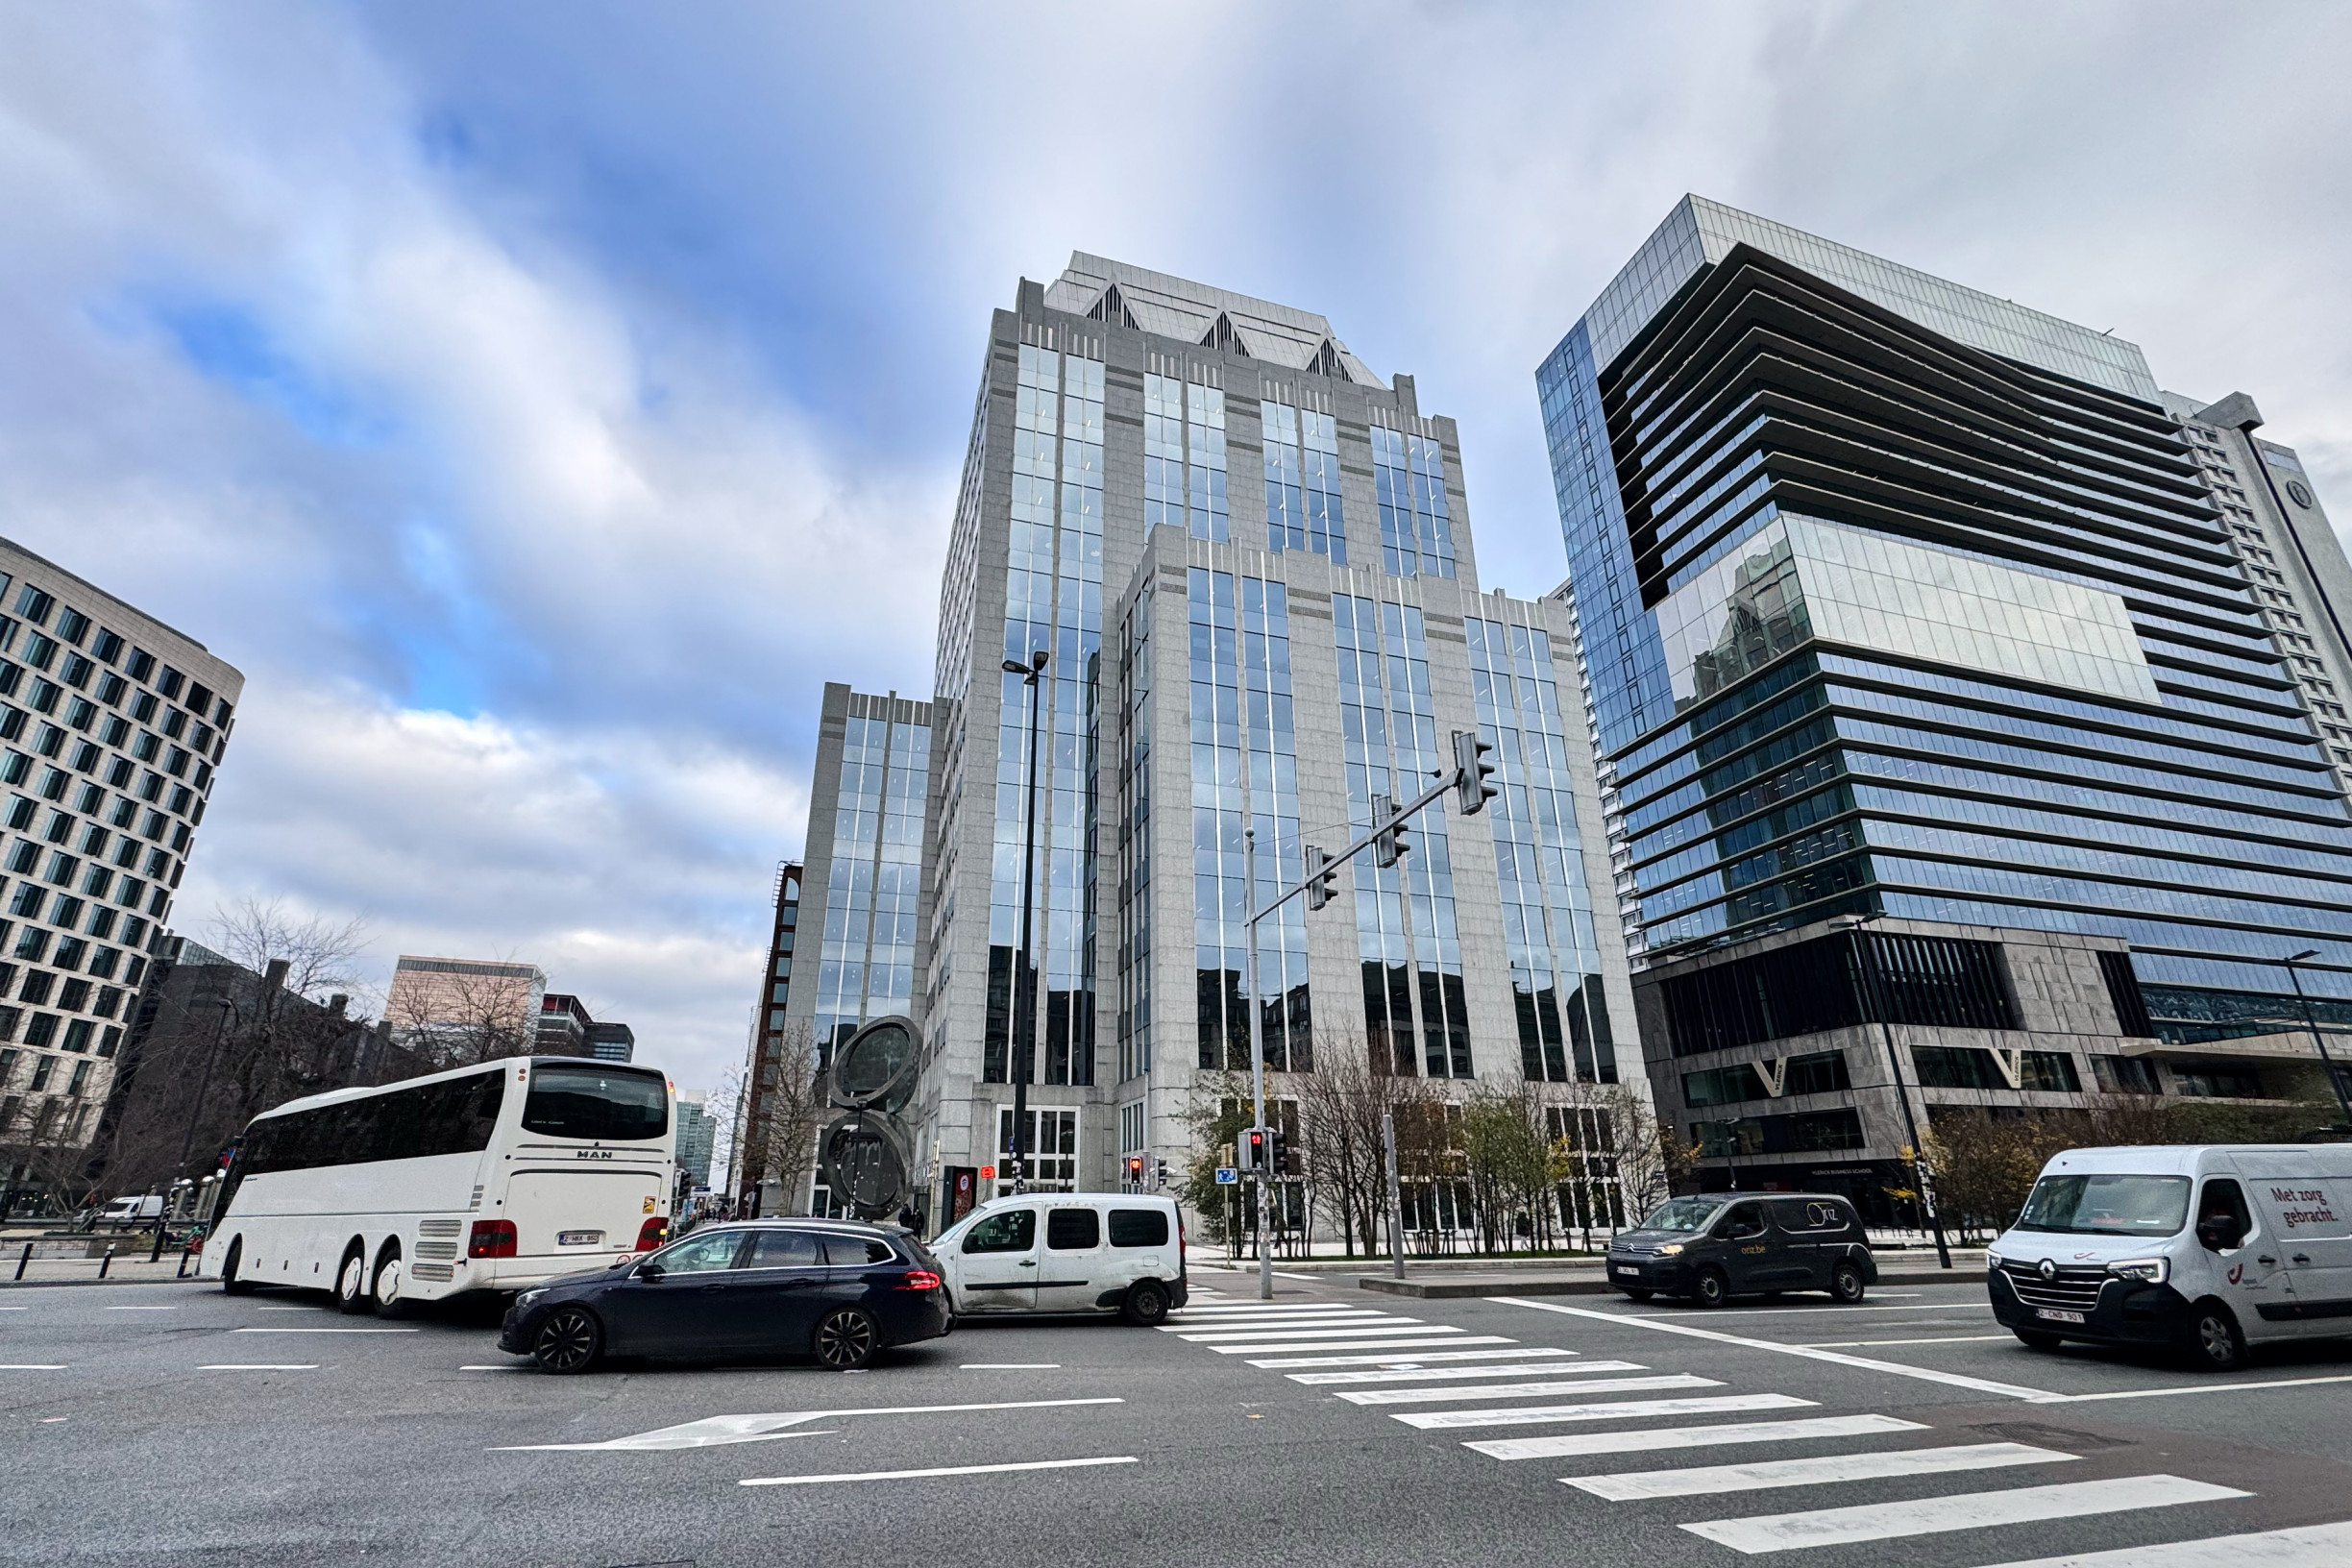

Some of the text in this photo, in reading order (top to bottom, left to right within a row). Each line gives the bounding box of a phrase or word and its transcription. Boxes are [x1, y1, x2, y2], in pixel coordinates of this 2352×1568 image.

[1775, 1064, 1783, 1090] VLERICK
[576, 1150, 613, 1159] MAN
[2270, 1188, 2327, 1206] Met zorg
[2283, 1206, 2339, 1228] gebracht.
